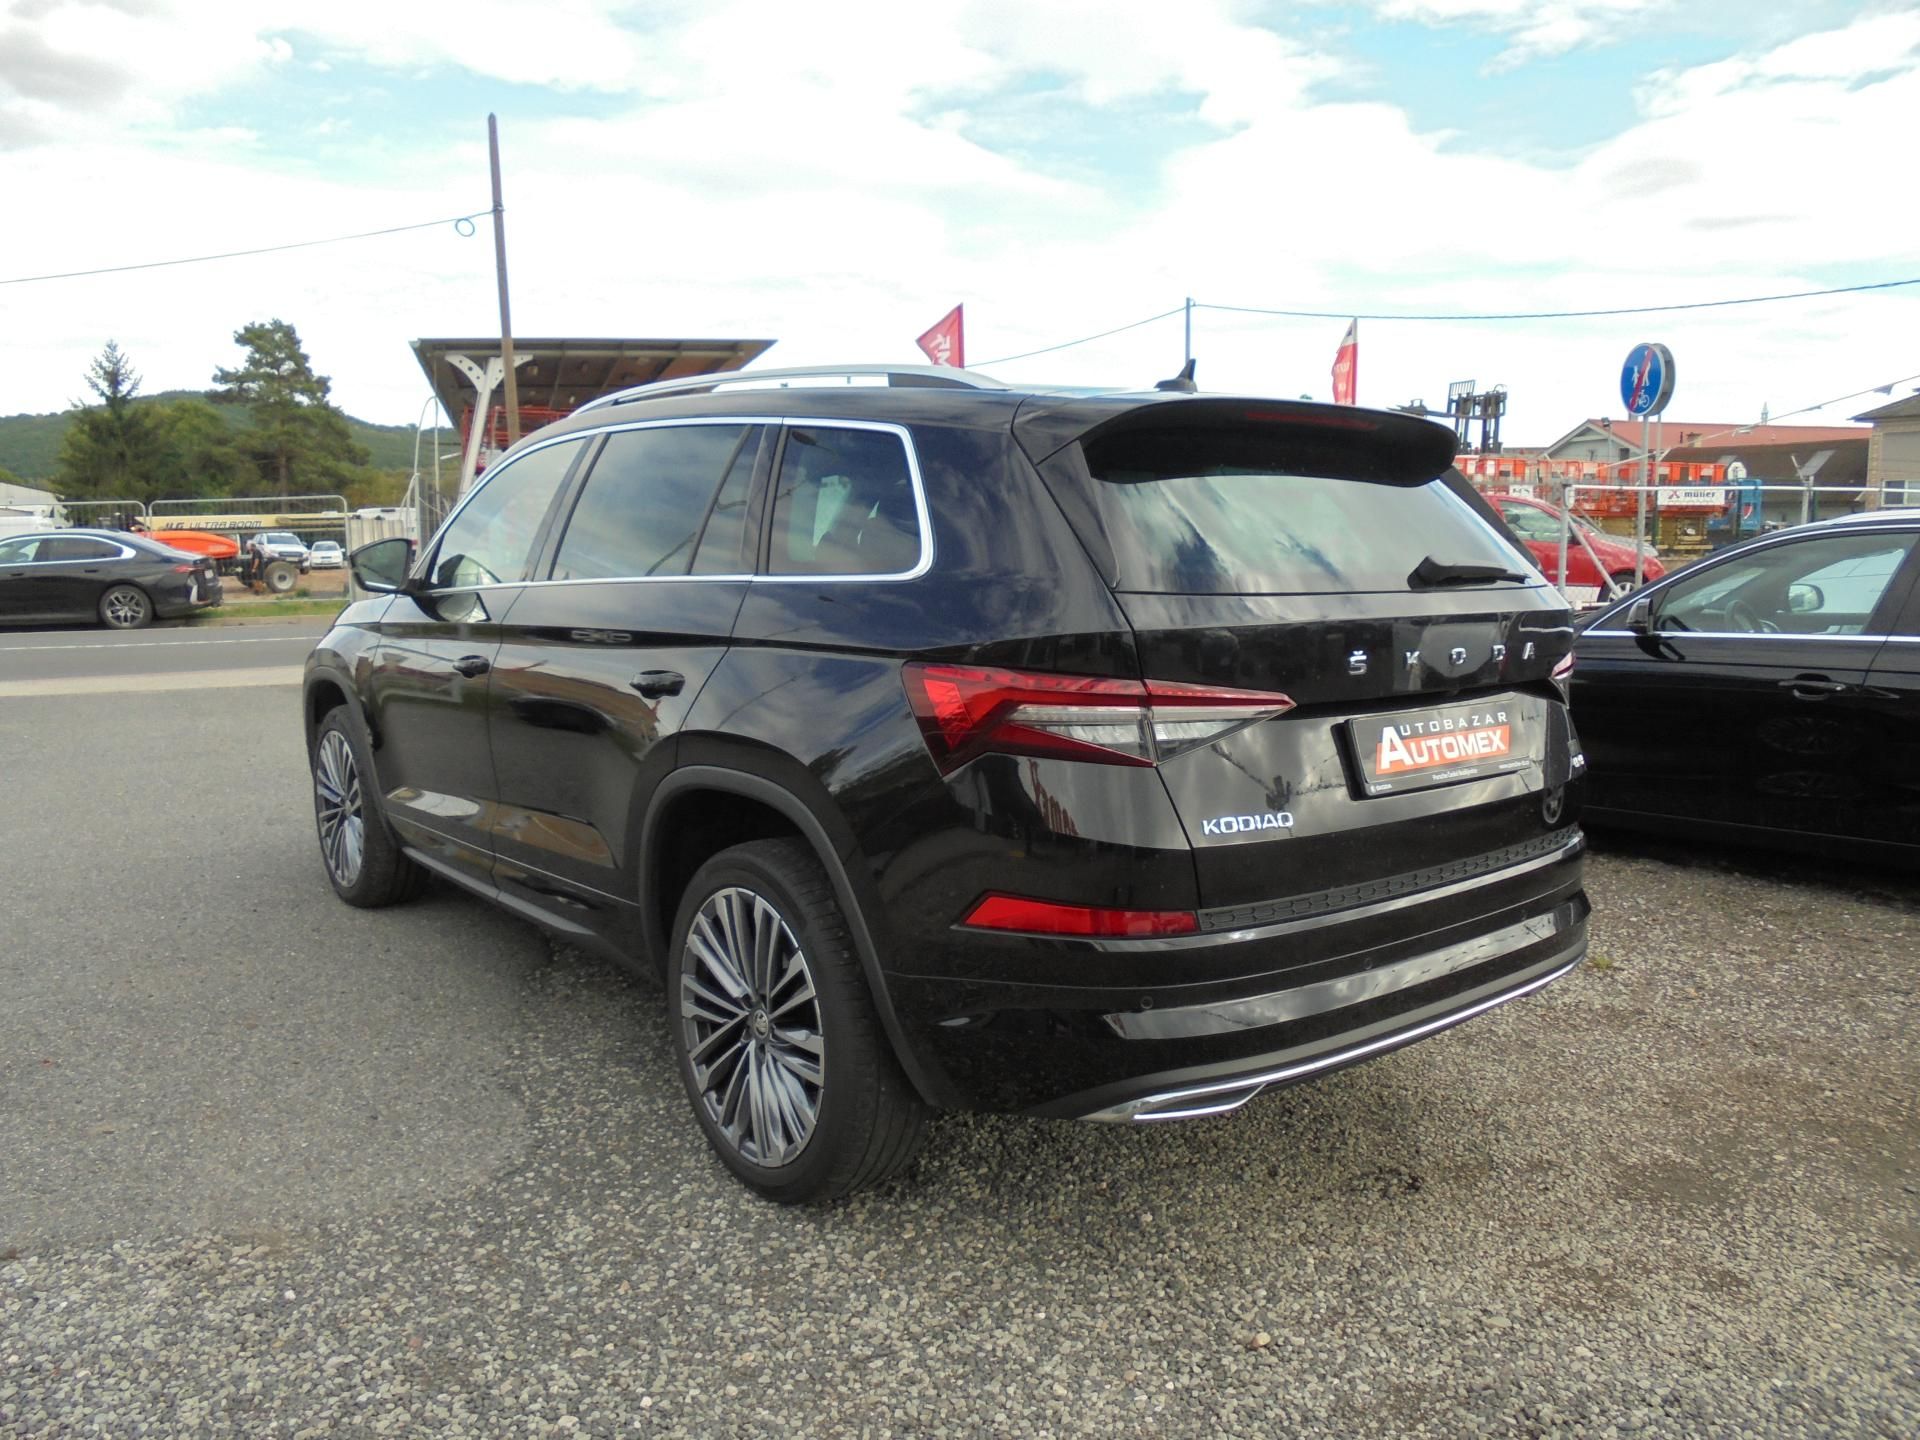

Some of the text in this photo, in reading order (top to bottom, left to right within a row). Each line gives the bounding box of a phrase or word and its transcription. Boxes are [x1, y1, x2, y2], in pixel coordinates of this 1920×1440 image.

[1348, 642, 1535, 675] ŠKODA
[1380, 726, 1506, 770] AUTOMEX
[1202, 812, 1294, 835] KODIAQ
